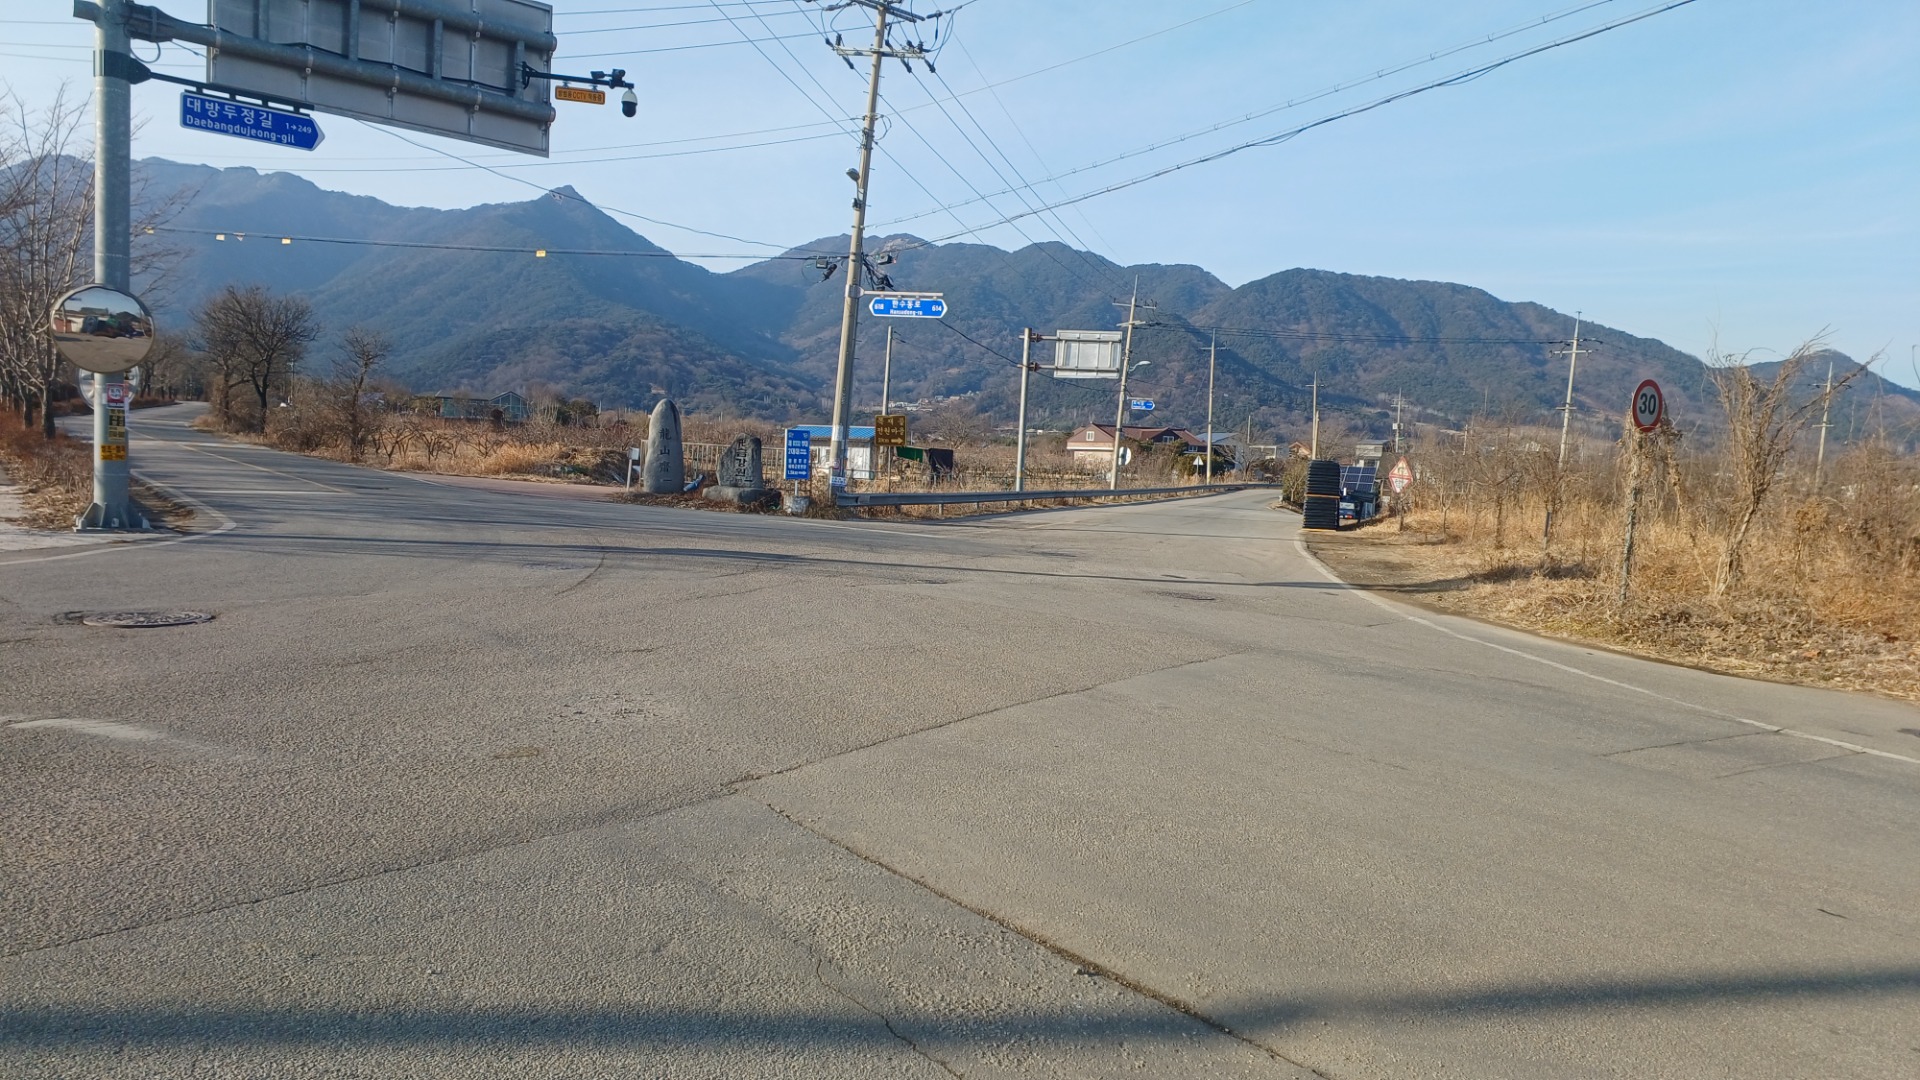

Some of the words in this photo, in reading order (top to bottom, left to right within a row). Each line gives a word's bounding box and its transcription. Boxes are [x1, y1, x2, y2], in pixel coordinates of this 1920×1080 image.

[572, 91, 587, 100] CCTV
[186, 97, 273, 129] 대방두정길
[186, 114, 295, 144] Daebangdujeong-gil
[892, 299, 921, 309] 한수동로
[1639, 392, 1657, 415] 30
